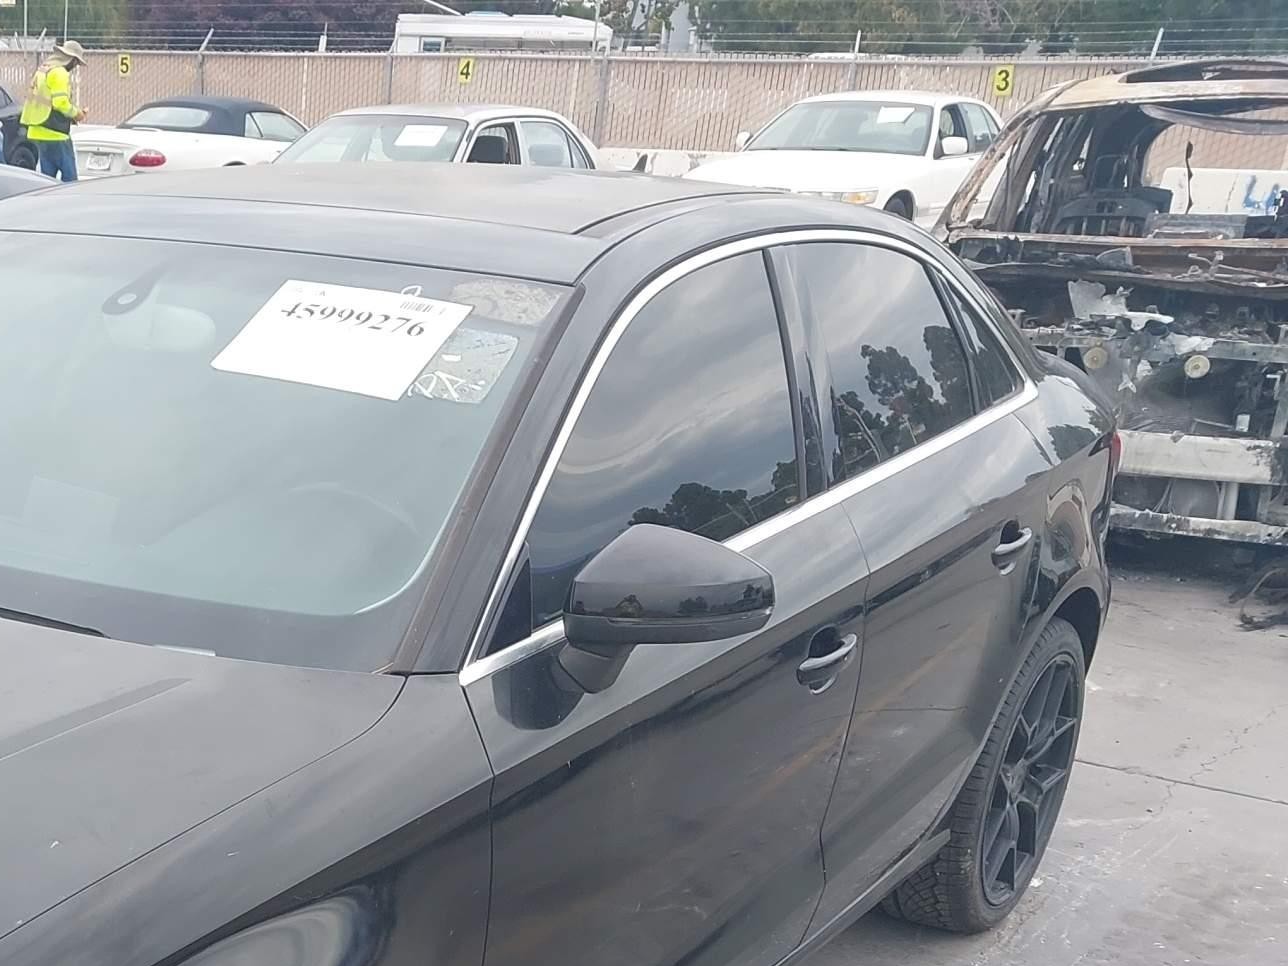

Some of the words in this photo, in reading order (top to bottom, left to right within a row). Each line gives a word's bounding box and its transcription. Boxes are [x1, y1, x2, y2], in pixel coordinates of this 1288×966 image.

[120, 56, 130, 74] 5
[459, 60, 471, 80] 4
[995, 69, 1010, 92] 3
[280, 301, 426, 337] 45999276
